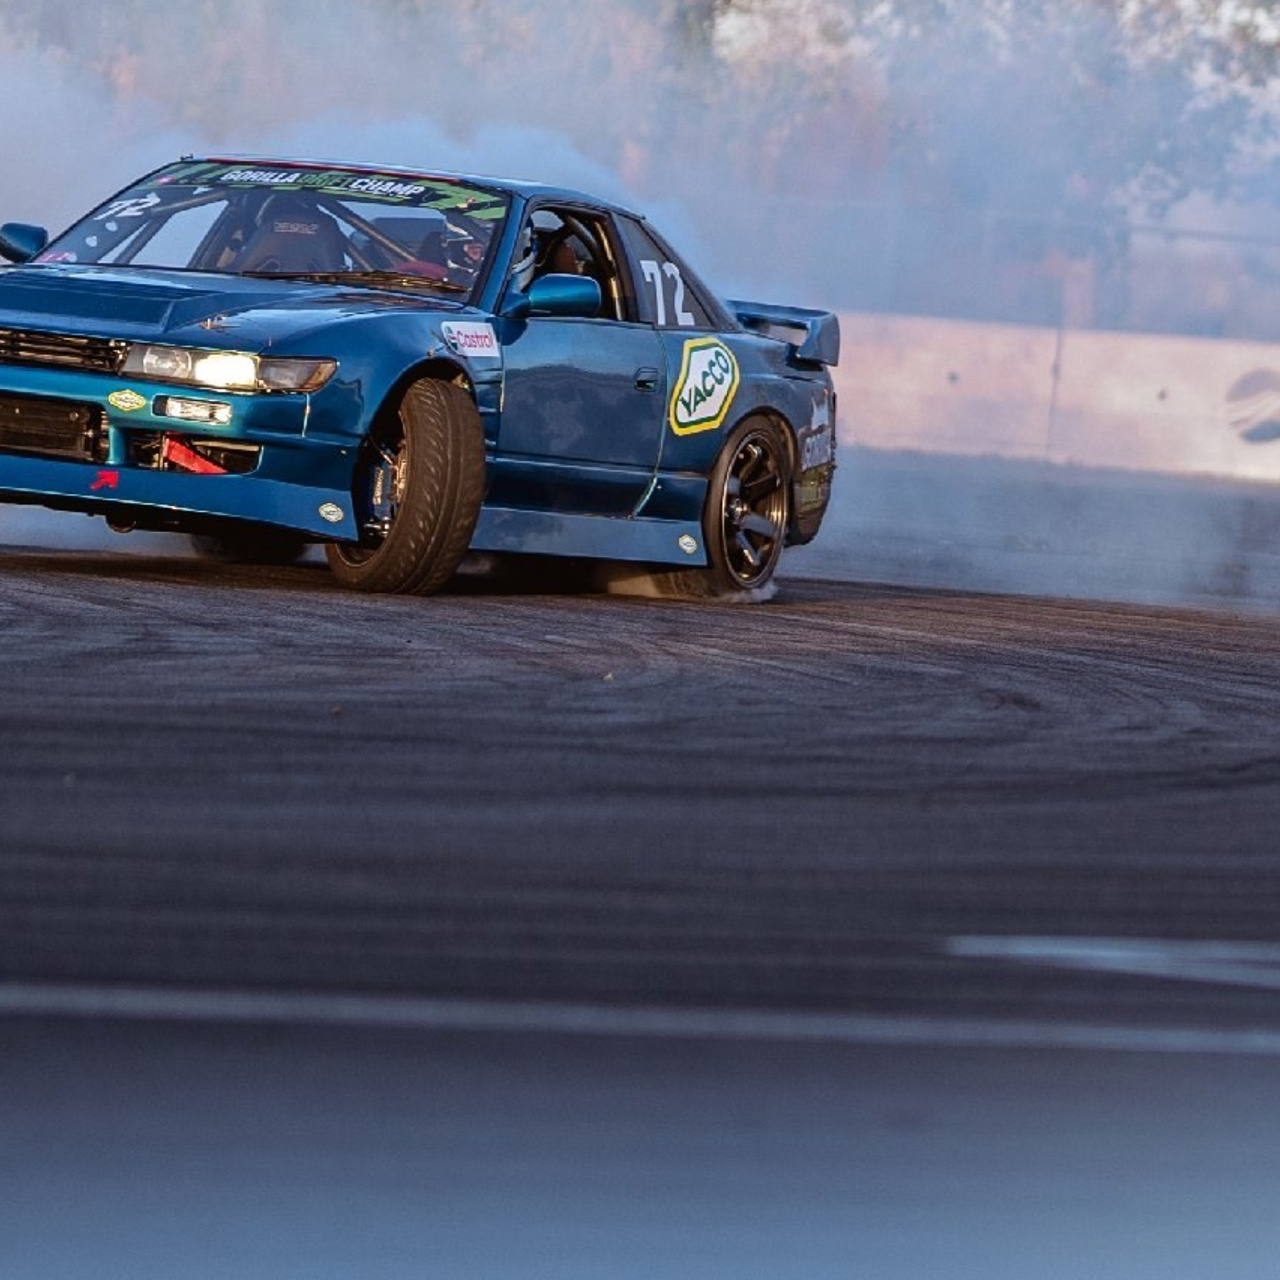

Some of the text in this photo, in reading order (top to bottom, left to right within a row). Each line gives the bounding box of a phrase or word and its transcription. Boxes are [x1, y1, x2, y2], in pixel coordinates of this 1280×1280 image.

[220, 170, 425, 197] GORILLA DRIFT CHAMP
[93, 192, 161, 220] 72
[640, 260, 695, 326] 72
[456, 330, 494, 349] Castrol
[679, 350, 730, 417] YACCO
